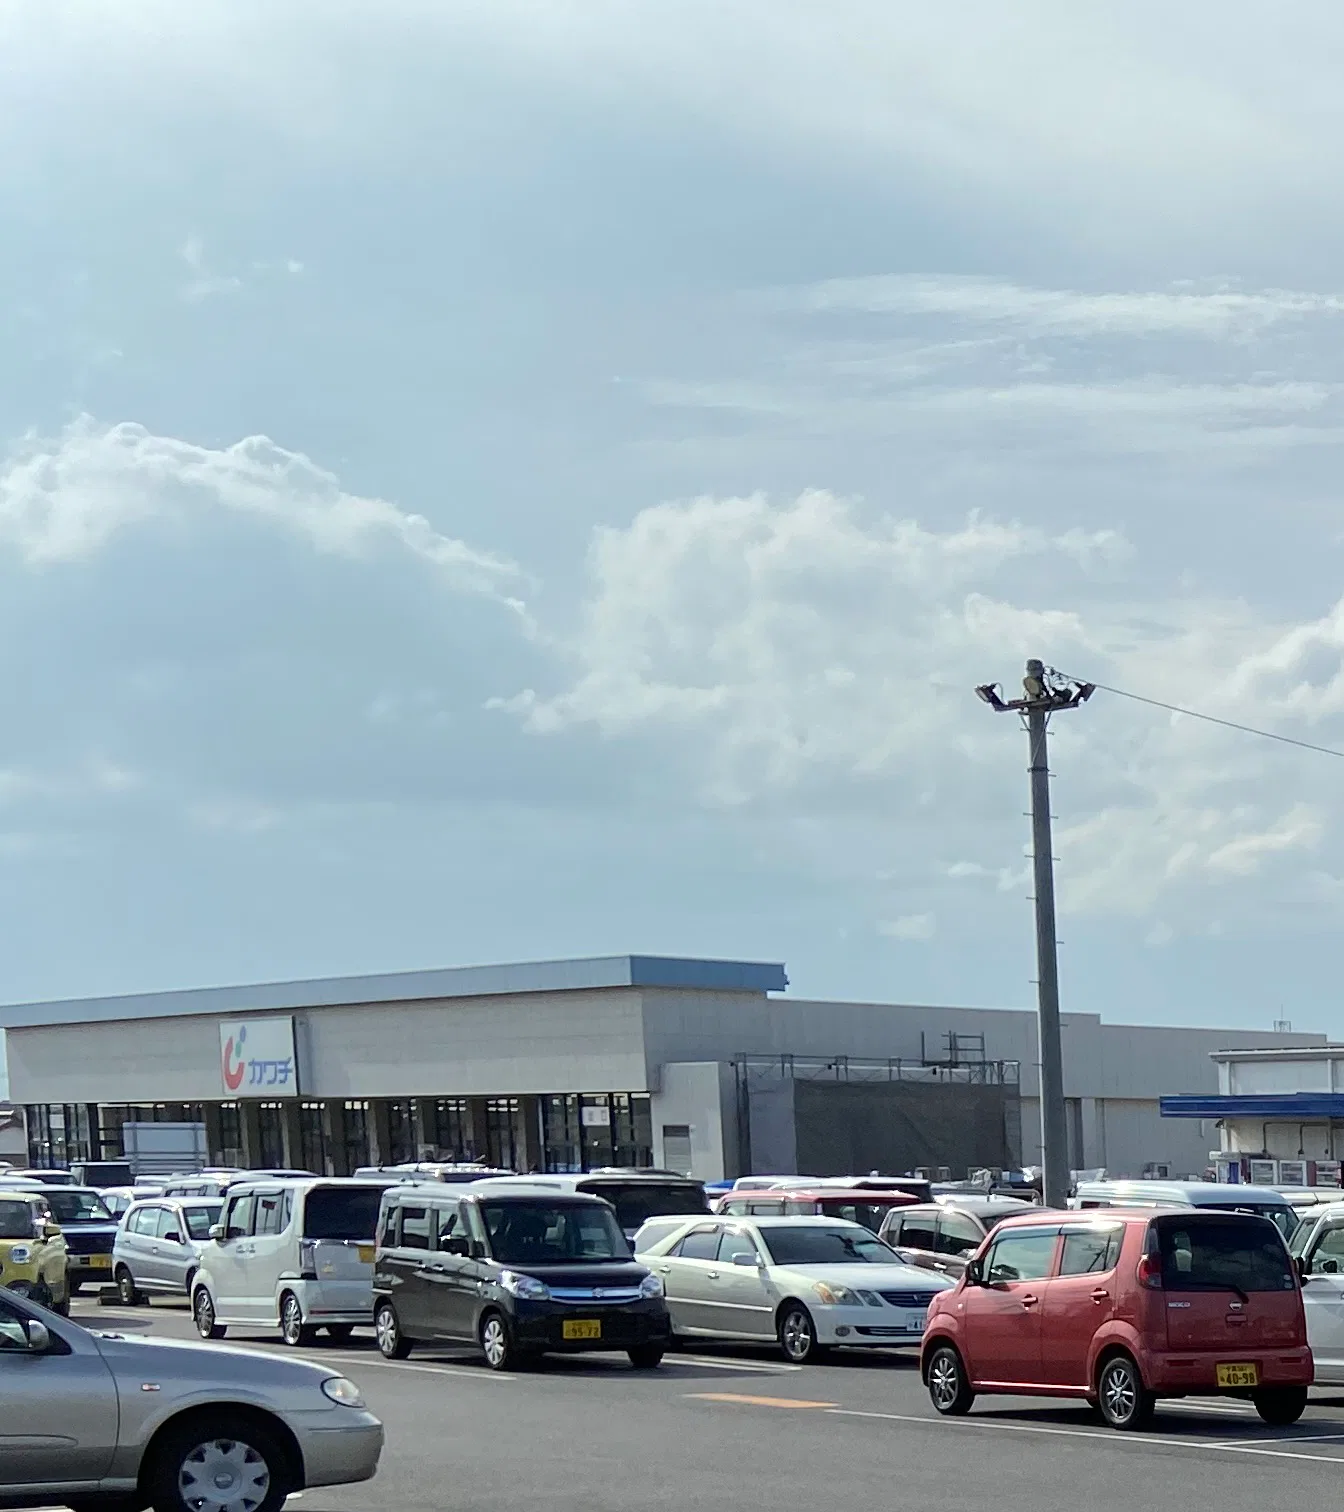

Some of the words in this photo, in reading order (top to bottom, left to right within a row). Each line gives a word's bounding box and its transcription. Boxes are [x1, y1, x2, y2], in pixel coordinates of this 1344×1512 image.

[249, 1057, 293, 1086] カワチ
[1226, 1372, 1256, 1385] 40-98
